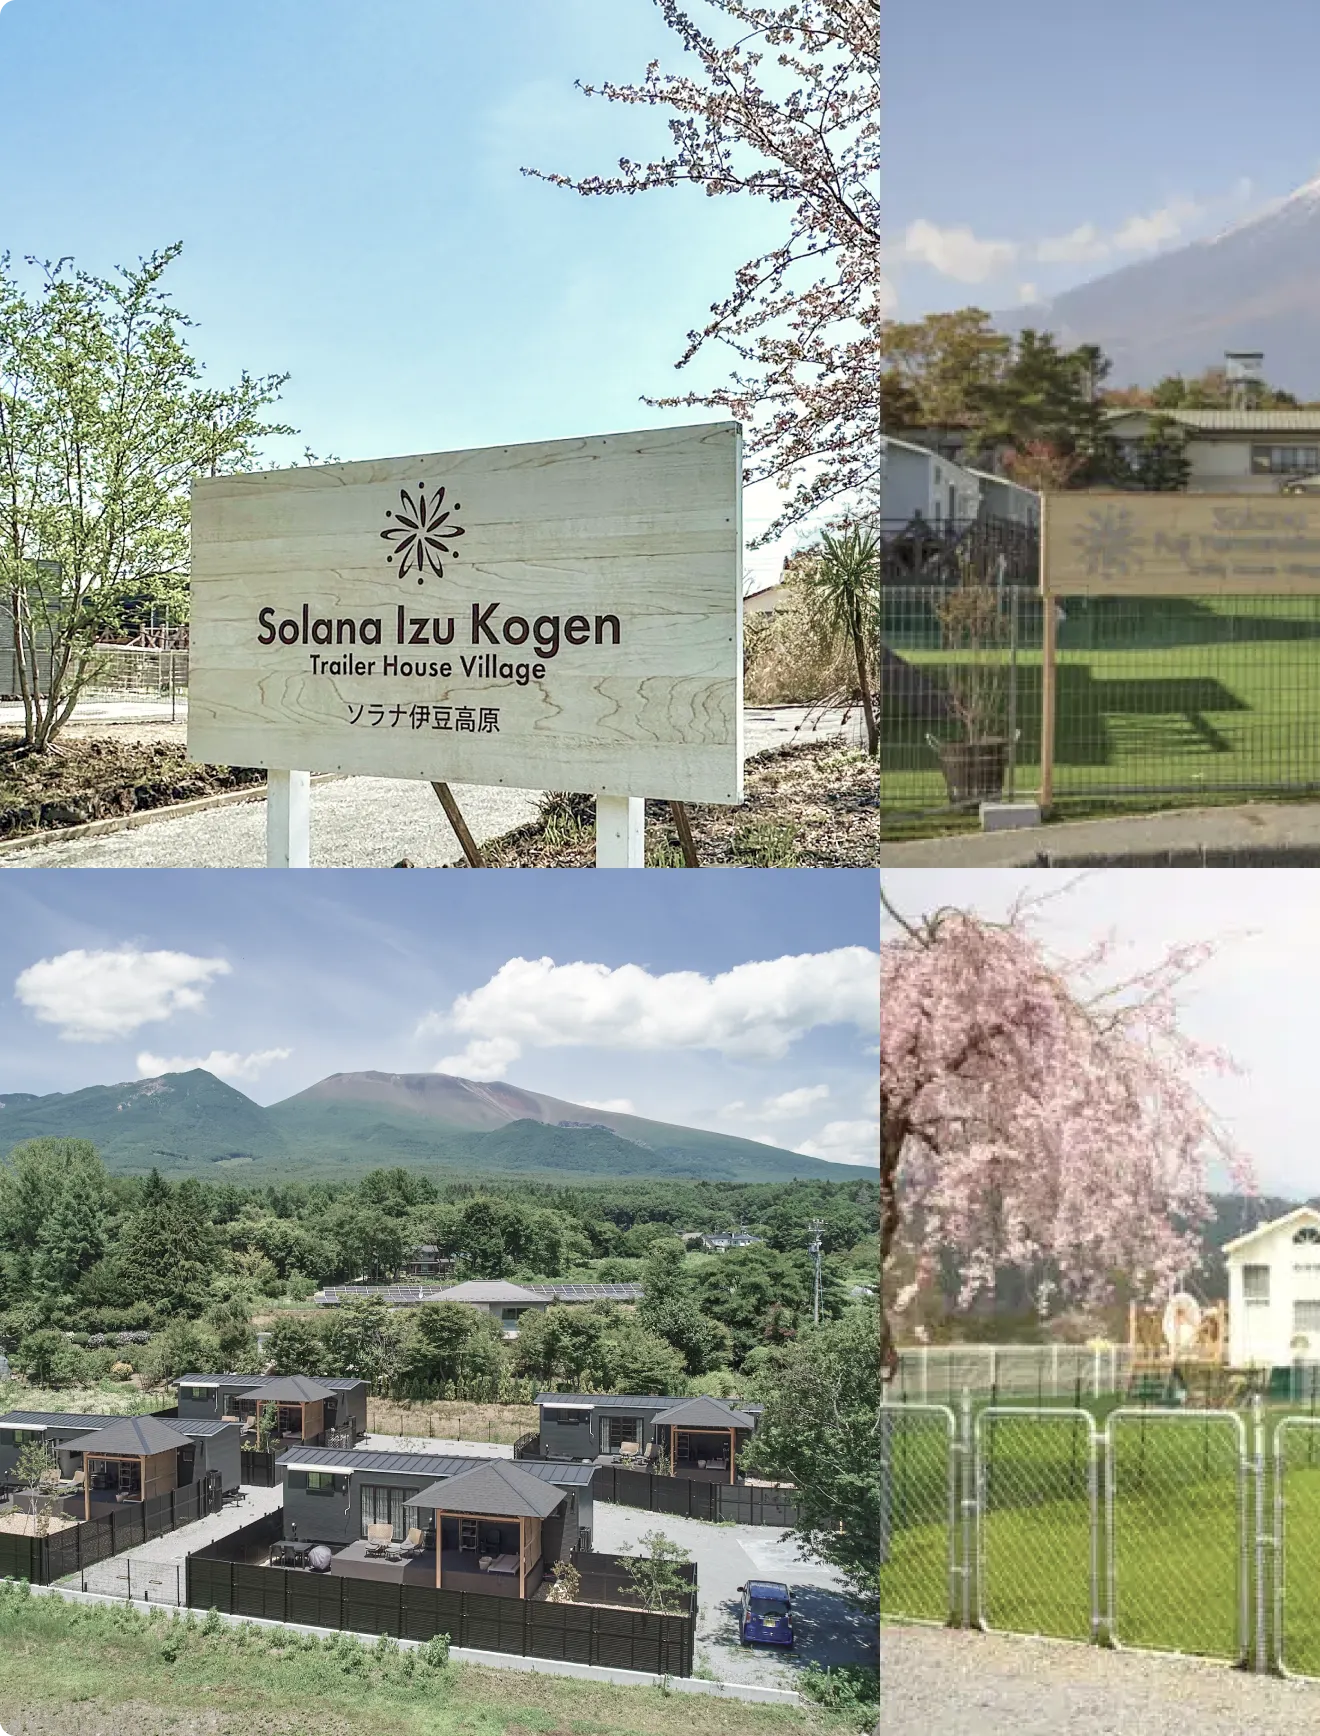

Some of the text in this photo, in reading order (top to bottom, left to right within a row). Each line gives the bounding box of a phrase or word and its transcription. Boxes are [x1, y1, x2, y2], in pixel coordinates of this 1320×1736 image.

[257, 602, 621, 659] Solana Izu Kogen
[310, 653, 546, 686] Trailer House Village
[347, 704, 501, 733] ソラナ伊豆高原
